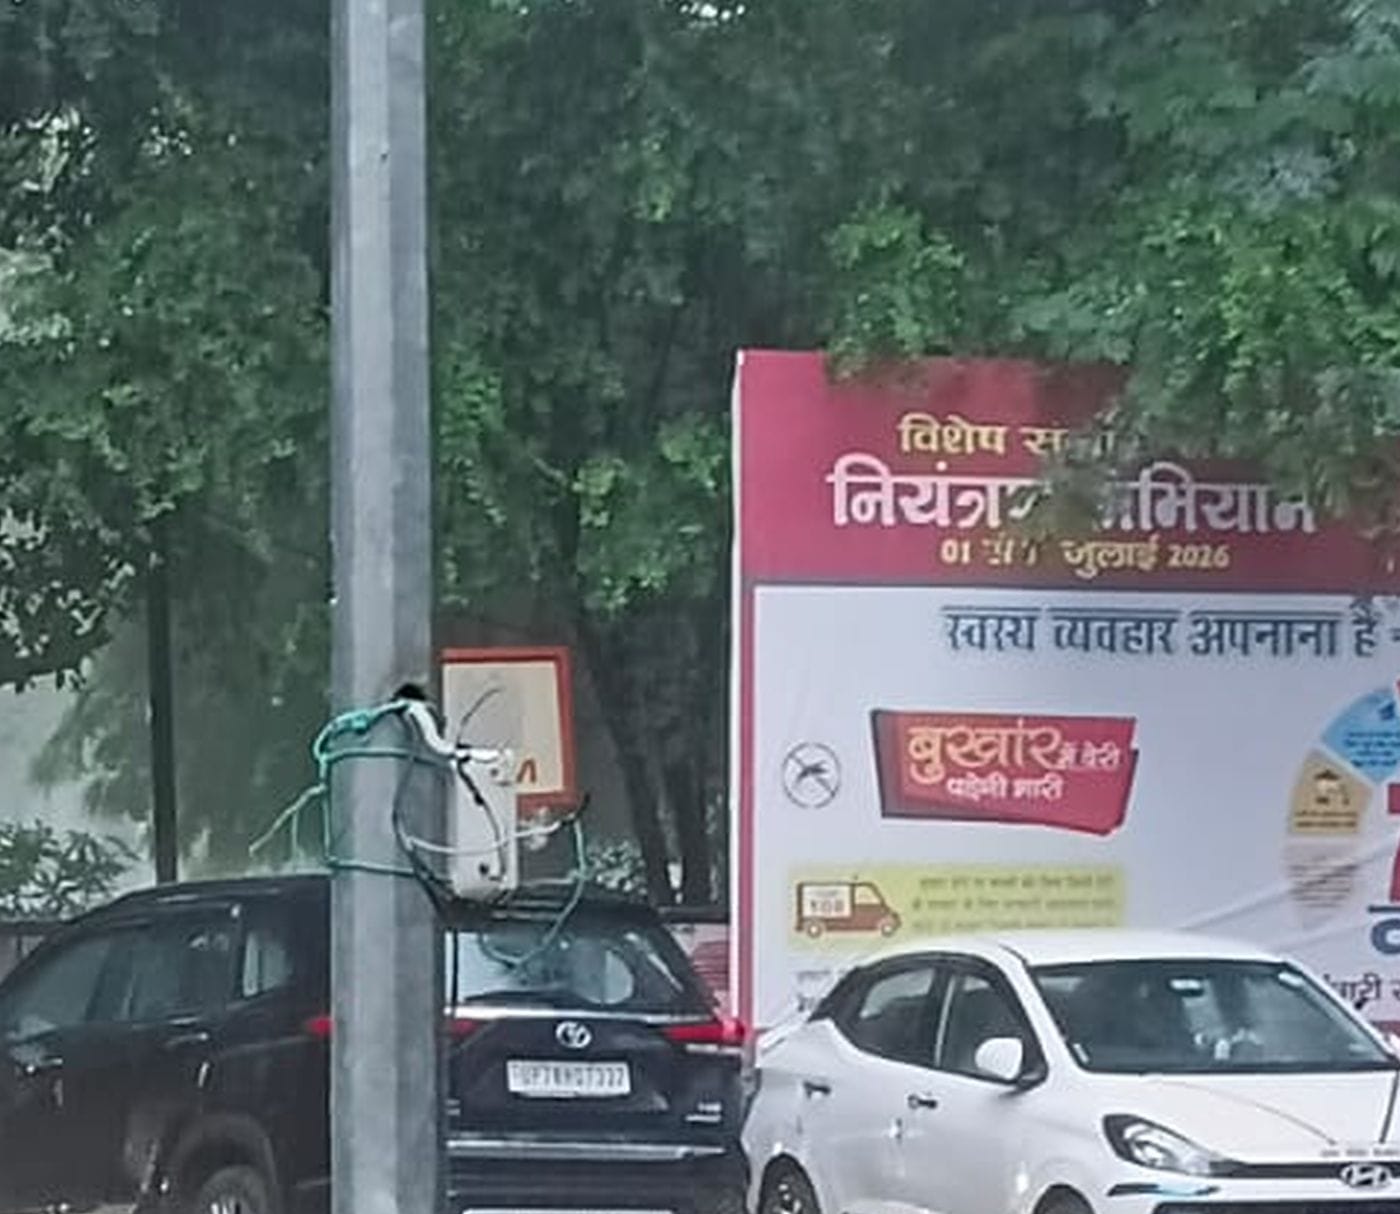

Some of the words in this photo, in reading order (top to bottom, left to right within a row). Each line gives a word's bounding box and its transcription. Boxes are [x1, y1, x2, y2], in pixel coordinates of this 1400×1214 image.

[897, 413, 1008, 454] विशेष
[940, 539, 971, 564] 01
[1060, 534, 1159, 579] जुलाई
[1167, 543, 1231, 567] 2026
[942, 606, 1042, 652] स्वस्थ
[1046, 607, 1182, 655] व्यवहार
[1190, 610, 1344, 658] अपनाना
